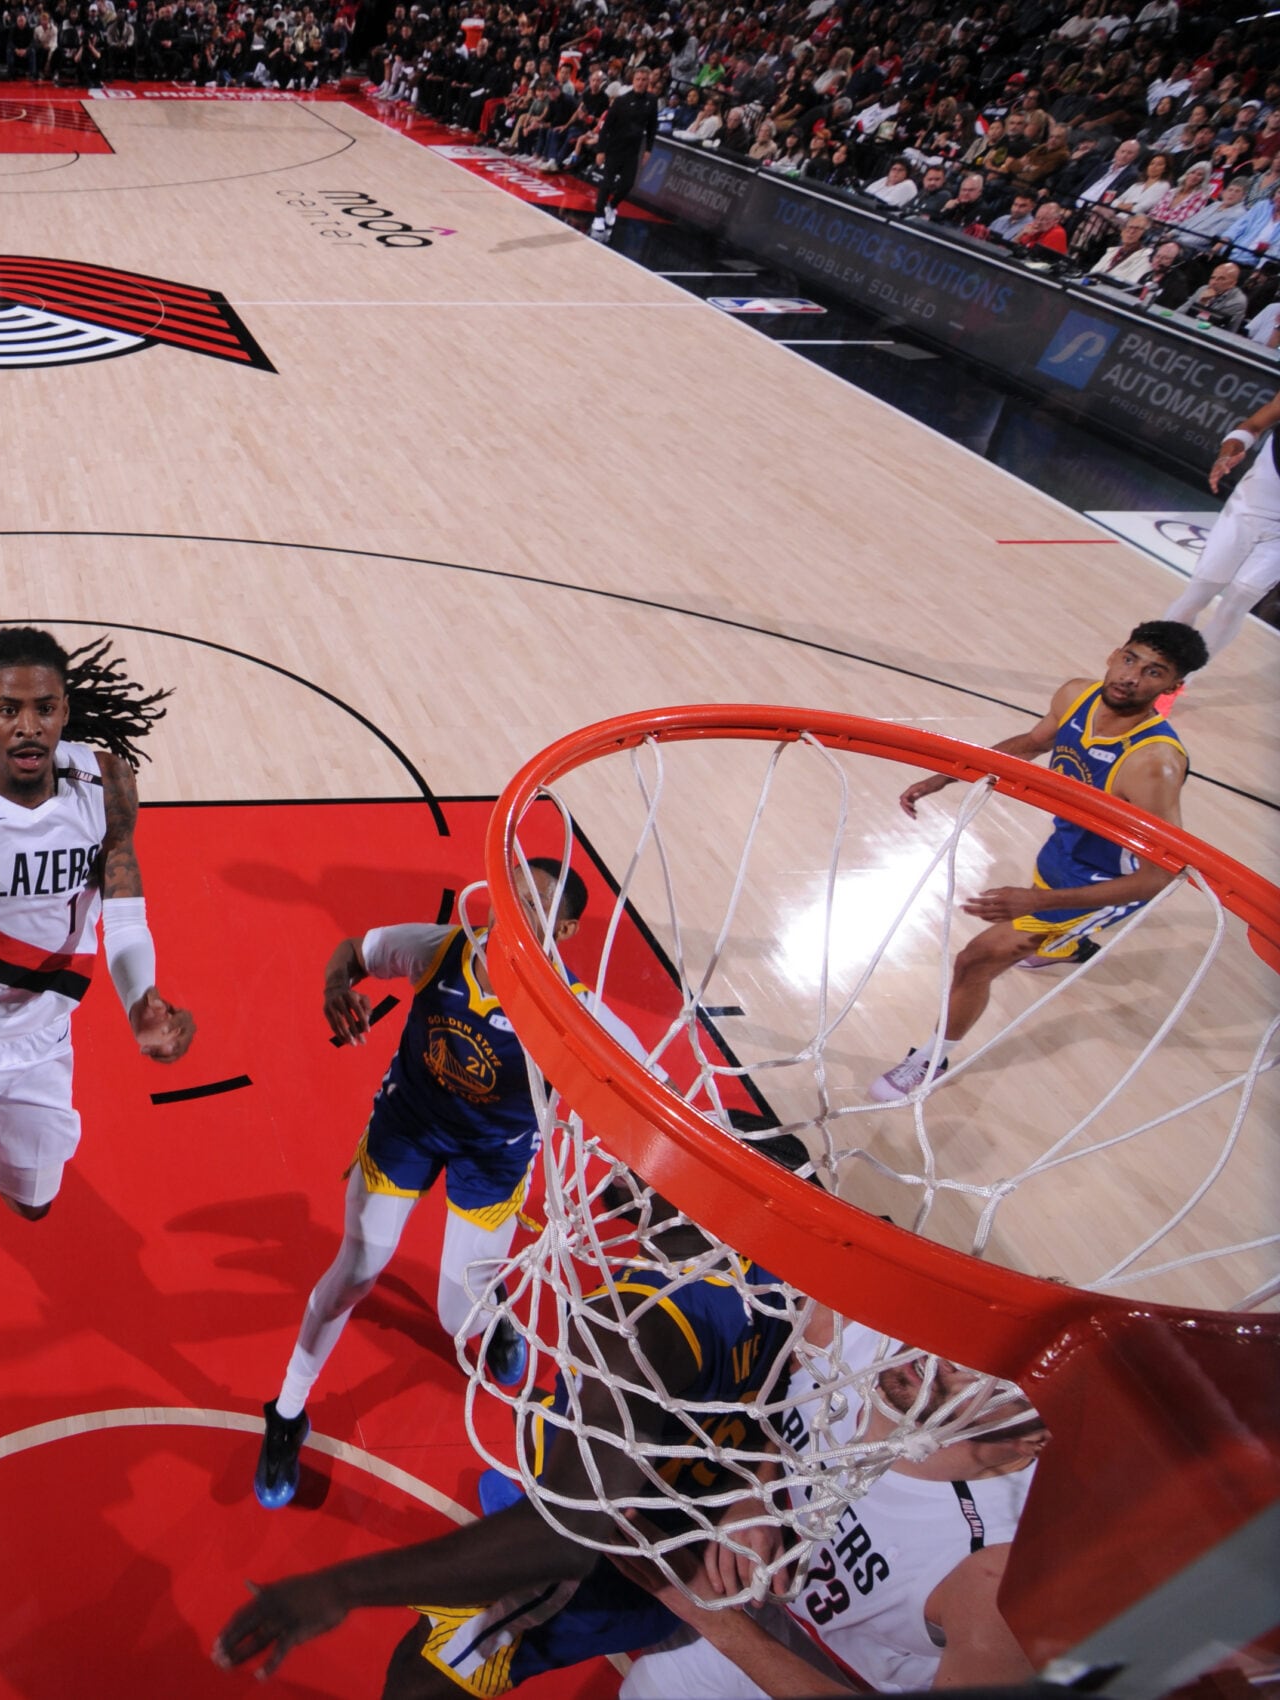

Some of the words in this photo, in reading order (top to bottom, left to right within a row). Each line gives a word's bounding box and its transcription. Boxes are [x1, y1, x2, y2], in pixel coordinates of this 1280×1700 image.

[477, 161, 565, 198] TOYOTA
[664, 176, 732, 213] AUTOMATION
[276, 189, 367, 248] center
[317, 190, 436, 248] moda
[775, 197, 825, 236] TOTAL
[826, 218, 891, 264] OFFICE
[890, 244, 1014, 314] SOLUTIONS
[795, 245, 866, 285] PROBLEM
[868, 278, 936, 319] SOLVED
[1101, 363, 1249, 434] AUTOMATI
[1118, 333, 1215, 388] PACIFIC
[1214, 373, 1276, 410] OFF
[67, 892, 80, 935] 1
[427, 1014, 473, 1035] GOLDEN
[475, 1033, 503, 1068] STATE
[465, 1055, 487, 1079] 21
